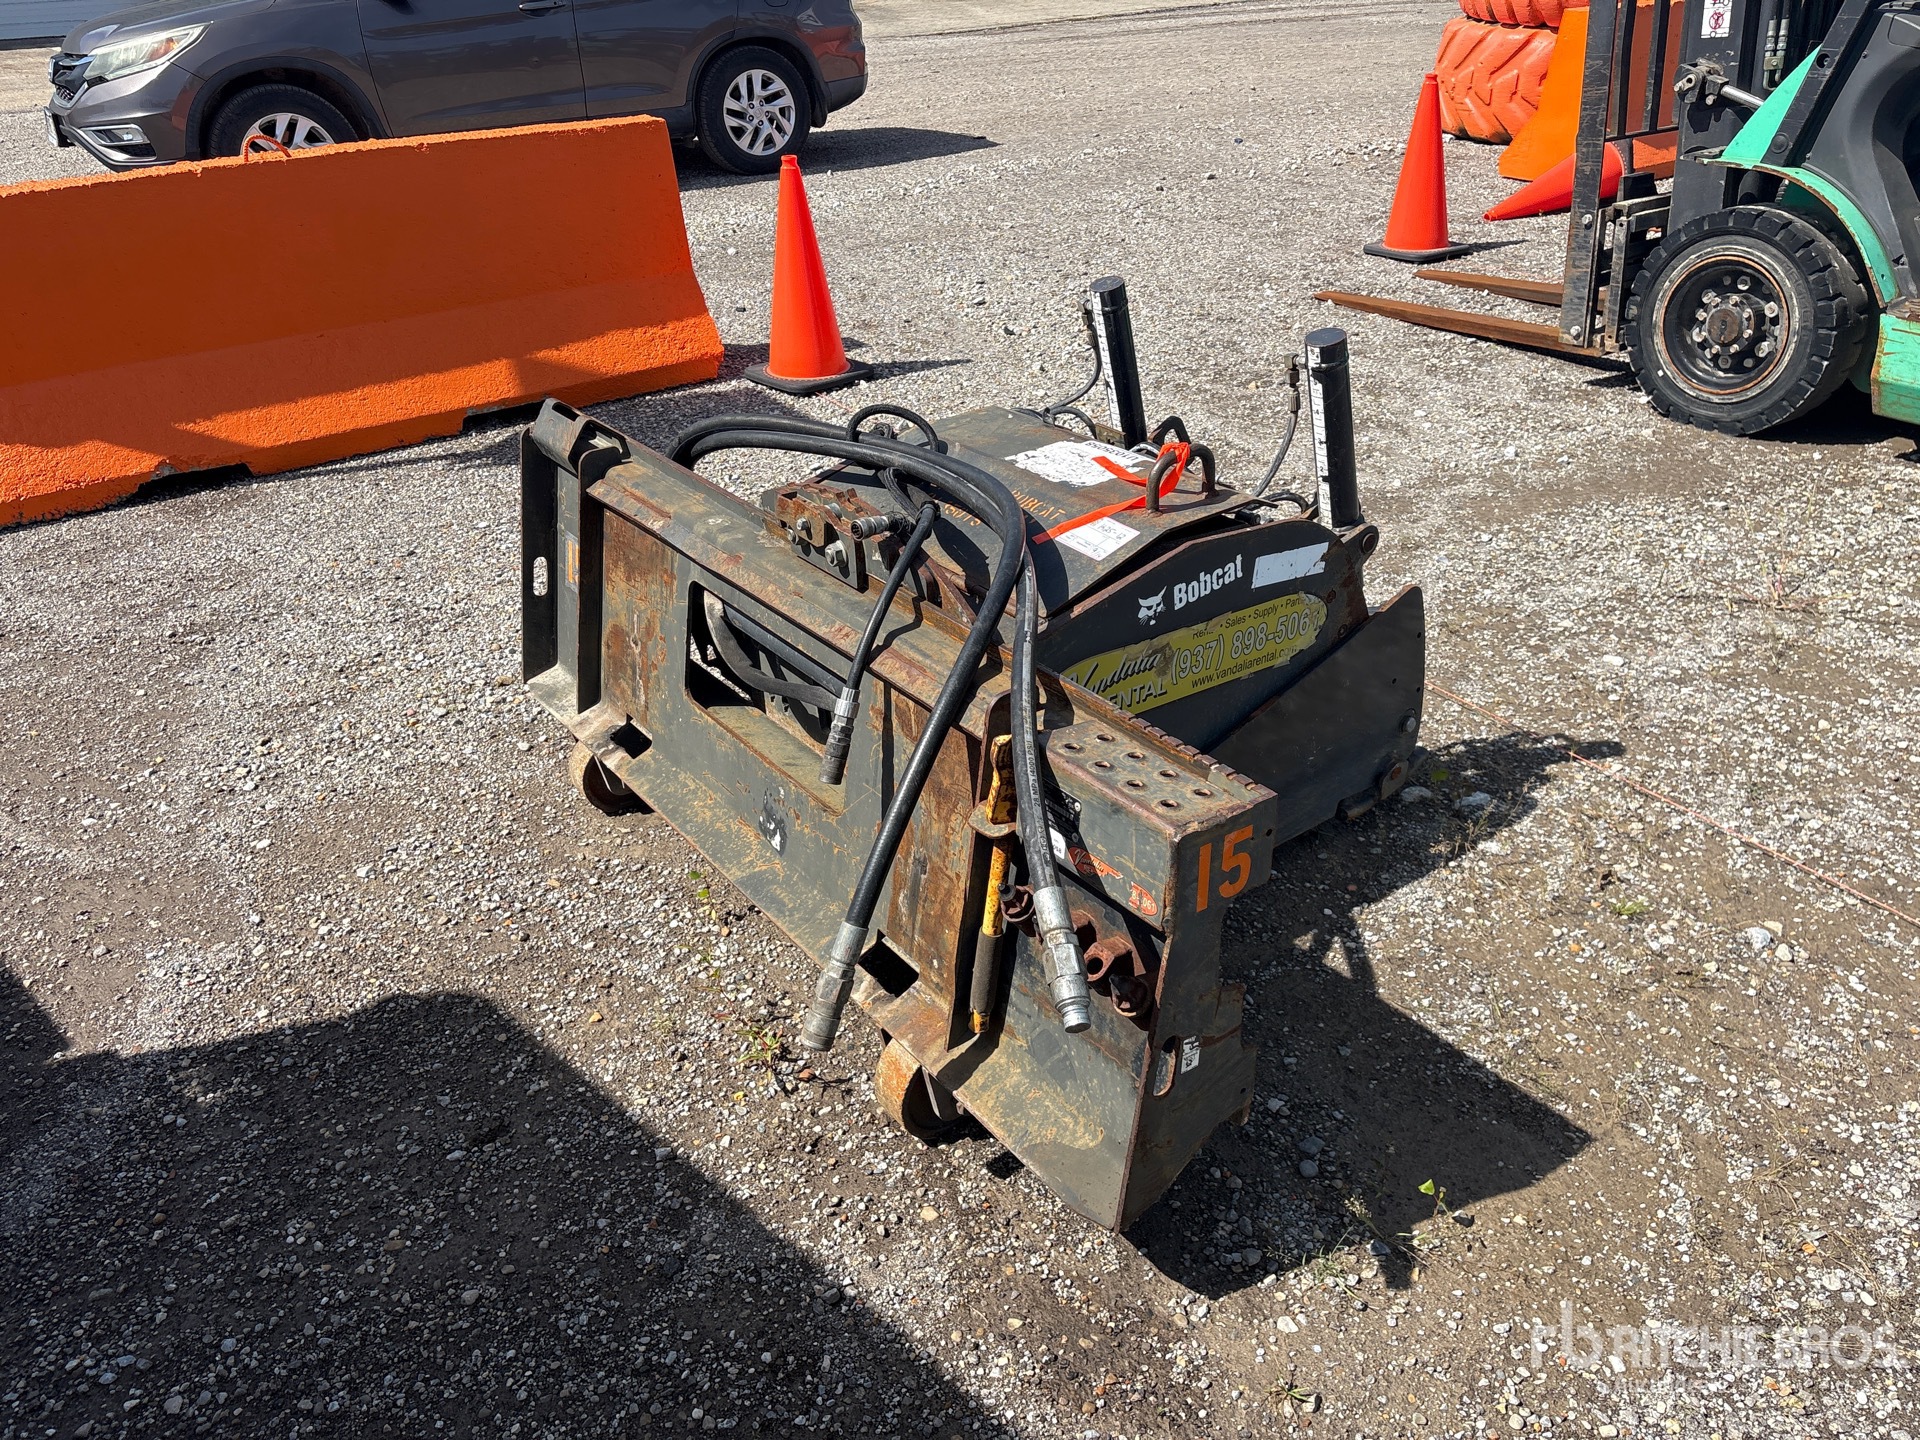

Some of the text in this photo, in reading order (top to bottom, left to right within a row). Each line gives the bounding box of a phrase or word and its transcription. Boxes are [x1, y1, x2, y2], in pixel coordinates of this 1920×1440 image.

[1173, 553, 1243, 611] Bobcat
[1225, 615, 1246, 629] Sales
[1253, 603, 1279, 620] Supply
[1171, 633, 1224, 686] (937)
[1107, 677, 1168, 711] ENTAL
[1030, 778, 1040, 798] MPa
[1196, 824, 1254, 913] 15
